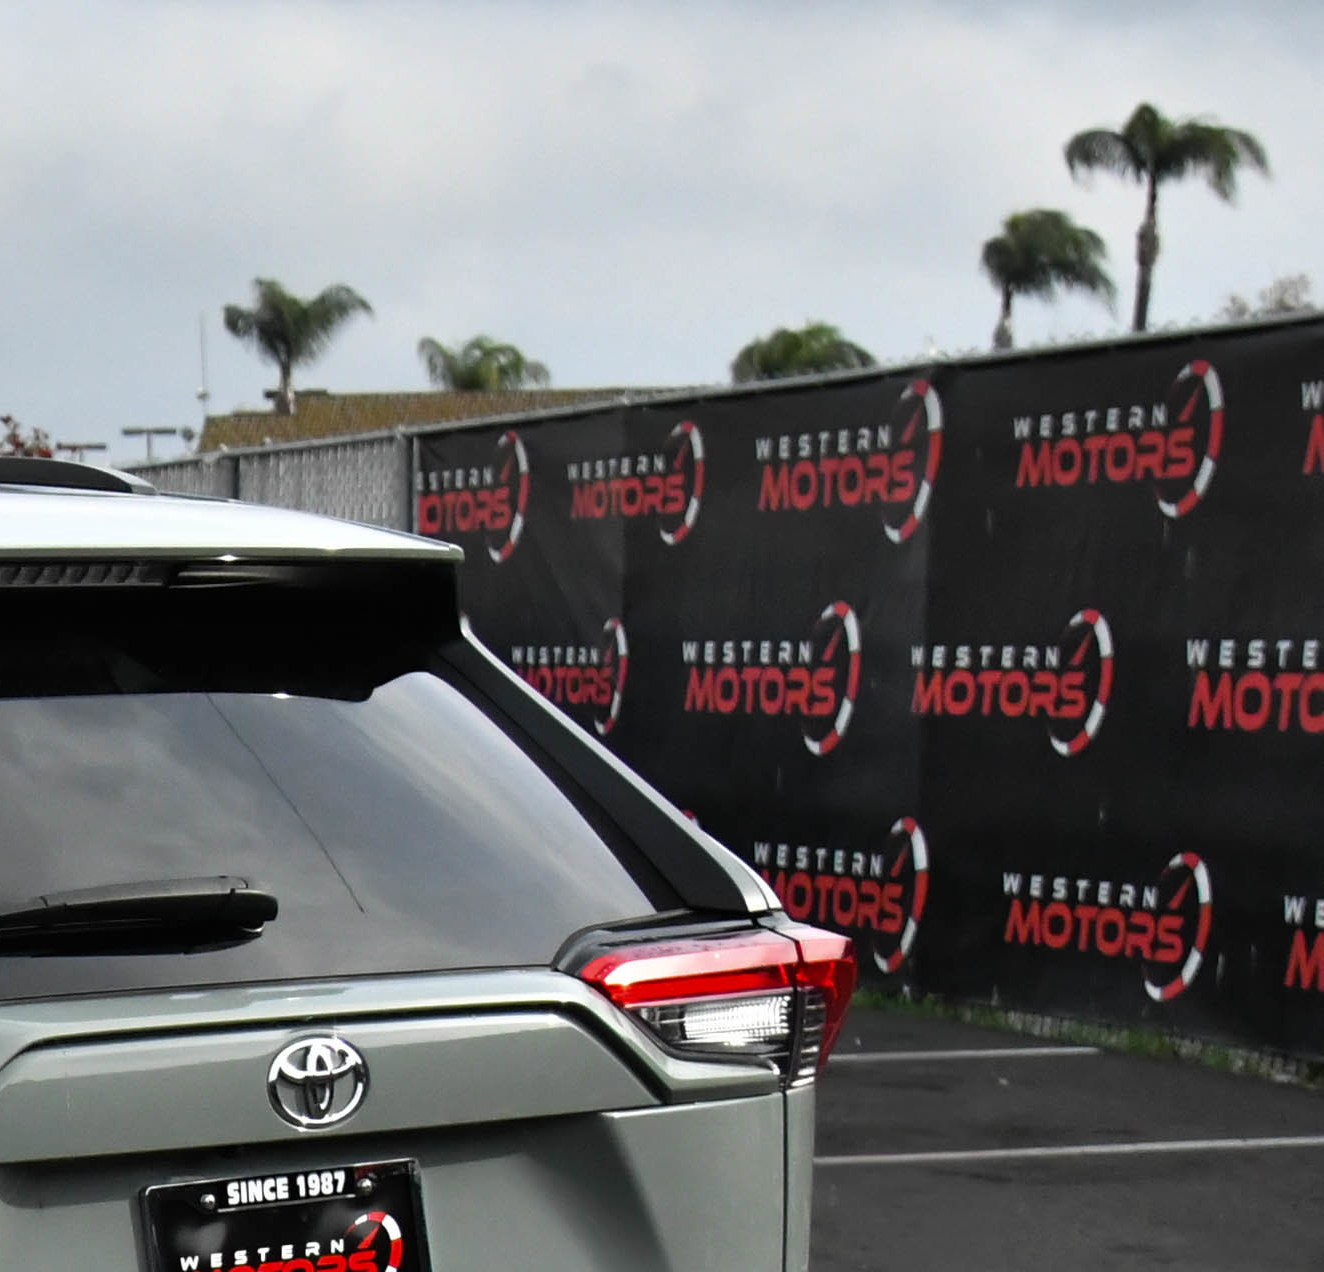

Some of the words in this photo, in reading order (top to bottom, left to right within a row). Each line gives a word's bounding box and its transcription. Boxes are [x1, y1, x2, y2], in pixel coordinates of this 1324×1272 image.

[1013, 404, 1168, 440] WESTERN
[755, 425, 892, 461] WESTERN
[1015, 427, 1196, 488] MOTORS
[417, 467, 493, 492] ESTERN
[567, 454, 666, 481] WESTERN
[757, 450, 916, 512] MOTORS
[417, 487, 511, 534] OTORS
[570, 473, 686, 520] MOTORS
[511, 645, 600, 665] WESTERN
[682, 640, 813, 665] WESTERN
[910, 644, 1061, 669] WESTERN
[684, 666, 837, 717] MOTORS
[911, 669, 1088, 719] MOTORS
[753, 841, 885, 879] WESTERN
[1002, 872, 1159, 910] WESTERN
[1004, 898, 1185, 964] MOTORS
[226, 1176, 290, 1206] SINCE
[296, 1170, 346, 1196] 1987
[180, 1238, 345, 1271] WESTERN
